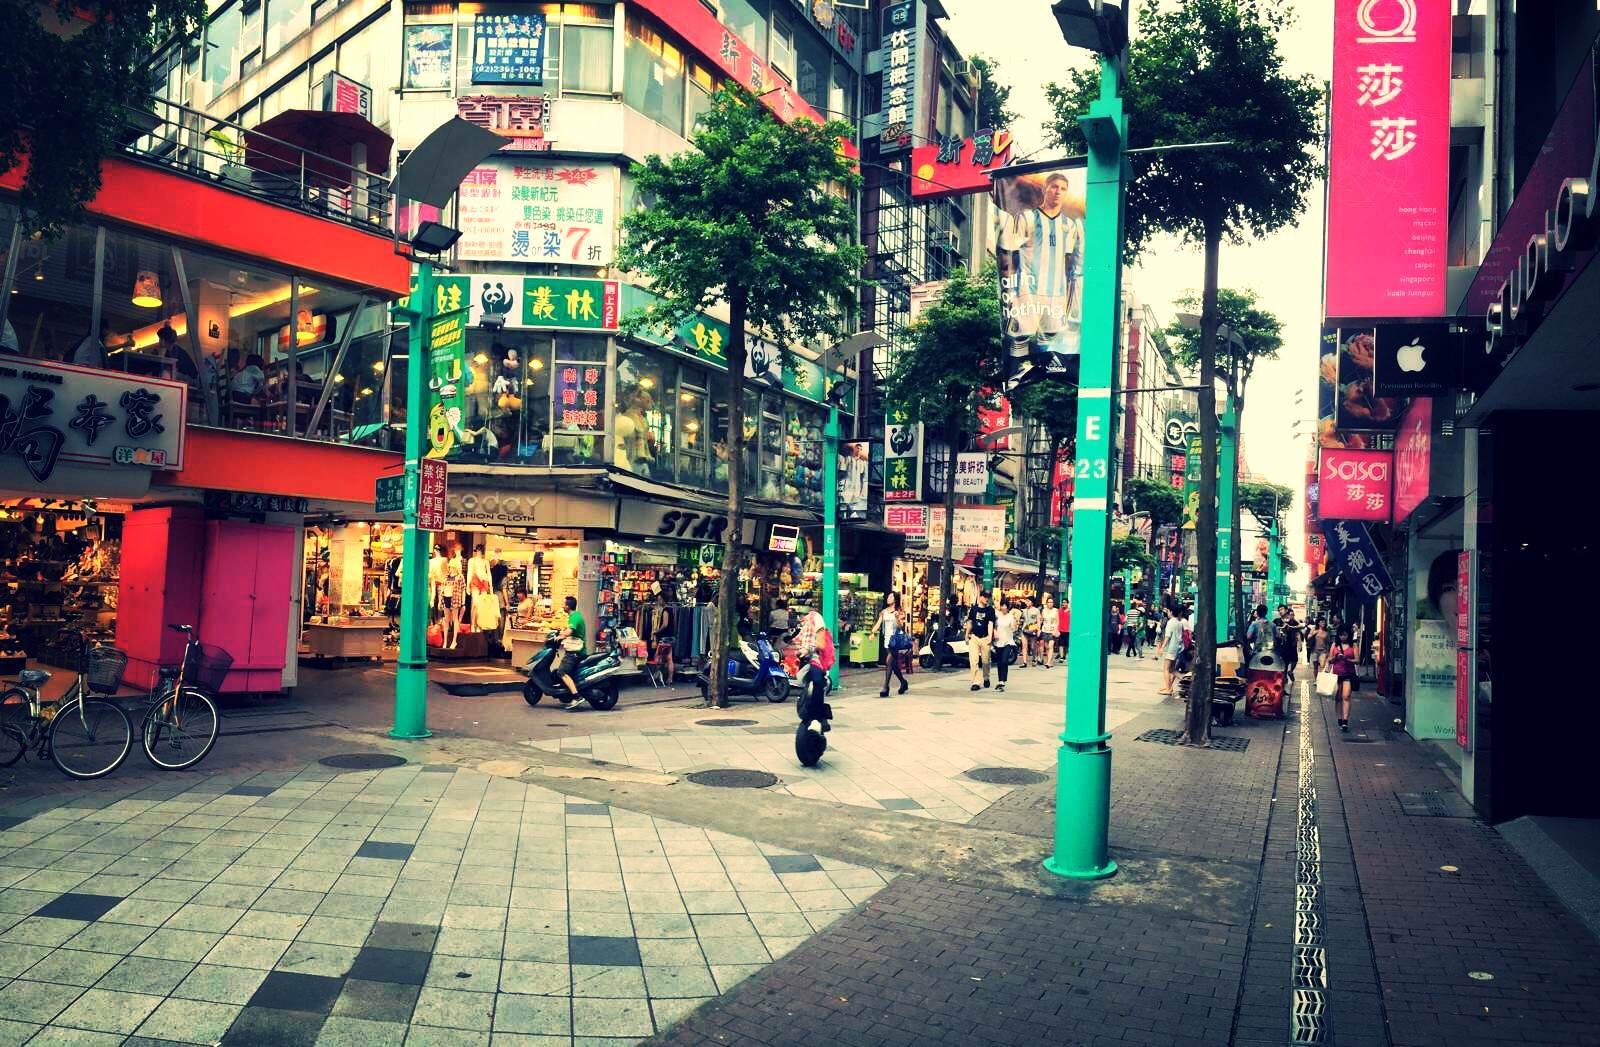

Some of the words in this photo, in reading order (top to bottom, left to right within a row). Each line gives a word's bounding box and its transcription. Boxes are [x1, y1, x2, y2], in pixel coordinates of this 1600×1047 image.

[1356, 63, 1417, 161] 莎莎
[1002, 301, 1066, 320] nothing
[22, 370, 64, 384] HOUSE
[1085, 415, 1101, 441] E
[1077, 458, 1107, 479] 23
[420, 463, 434, 529] 禁止停車
[433, 463, 447, 529] 徒步區內
[1346, 483, 1385, 511] 莎莎
[446, 512, 494, 520] FASHION
[497, 514, 535, 522] CLOTH
